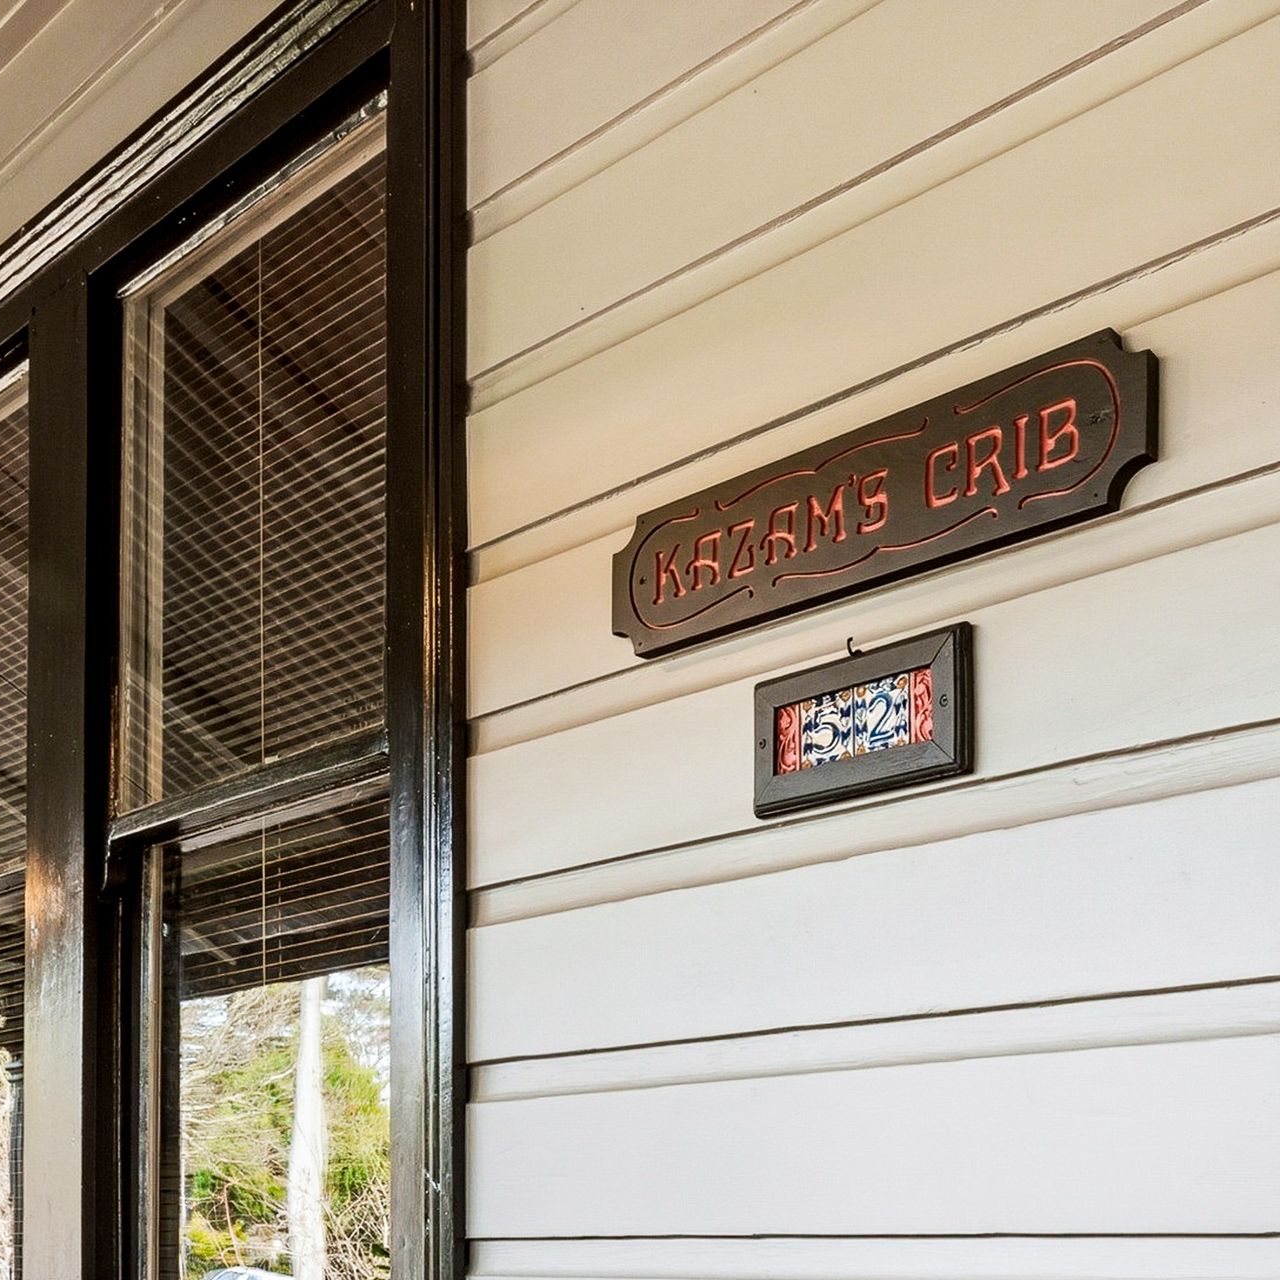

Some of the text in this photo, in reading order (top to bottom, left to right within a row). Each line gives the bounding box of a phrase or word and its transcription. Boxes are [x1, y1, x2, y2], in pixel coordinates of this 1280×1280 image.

[651, 398, 1080, 607] KAZAM'S CRIB
[812, 690, 895, 755] 52
